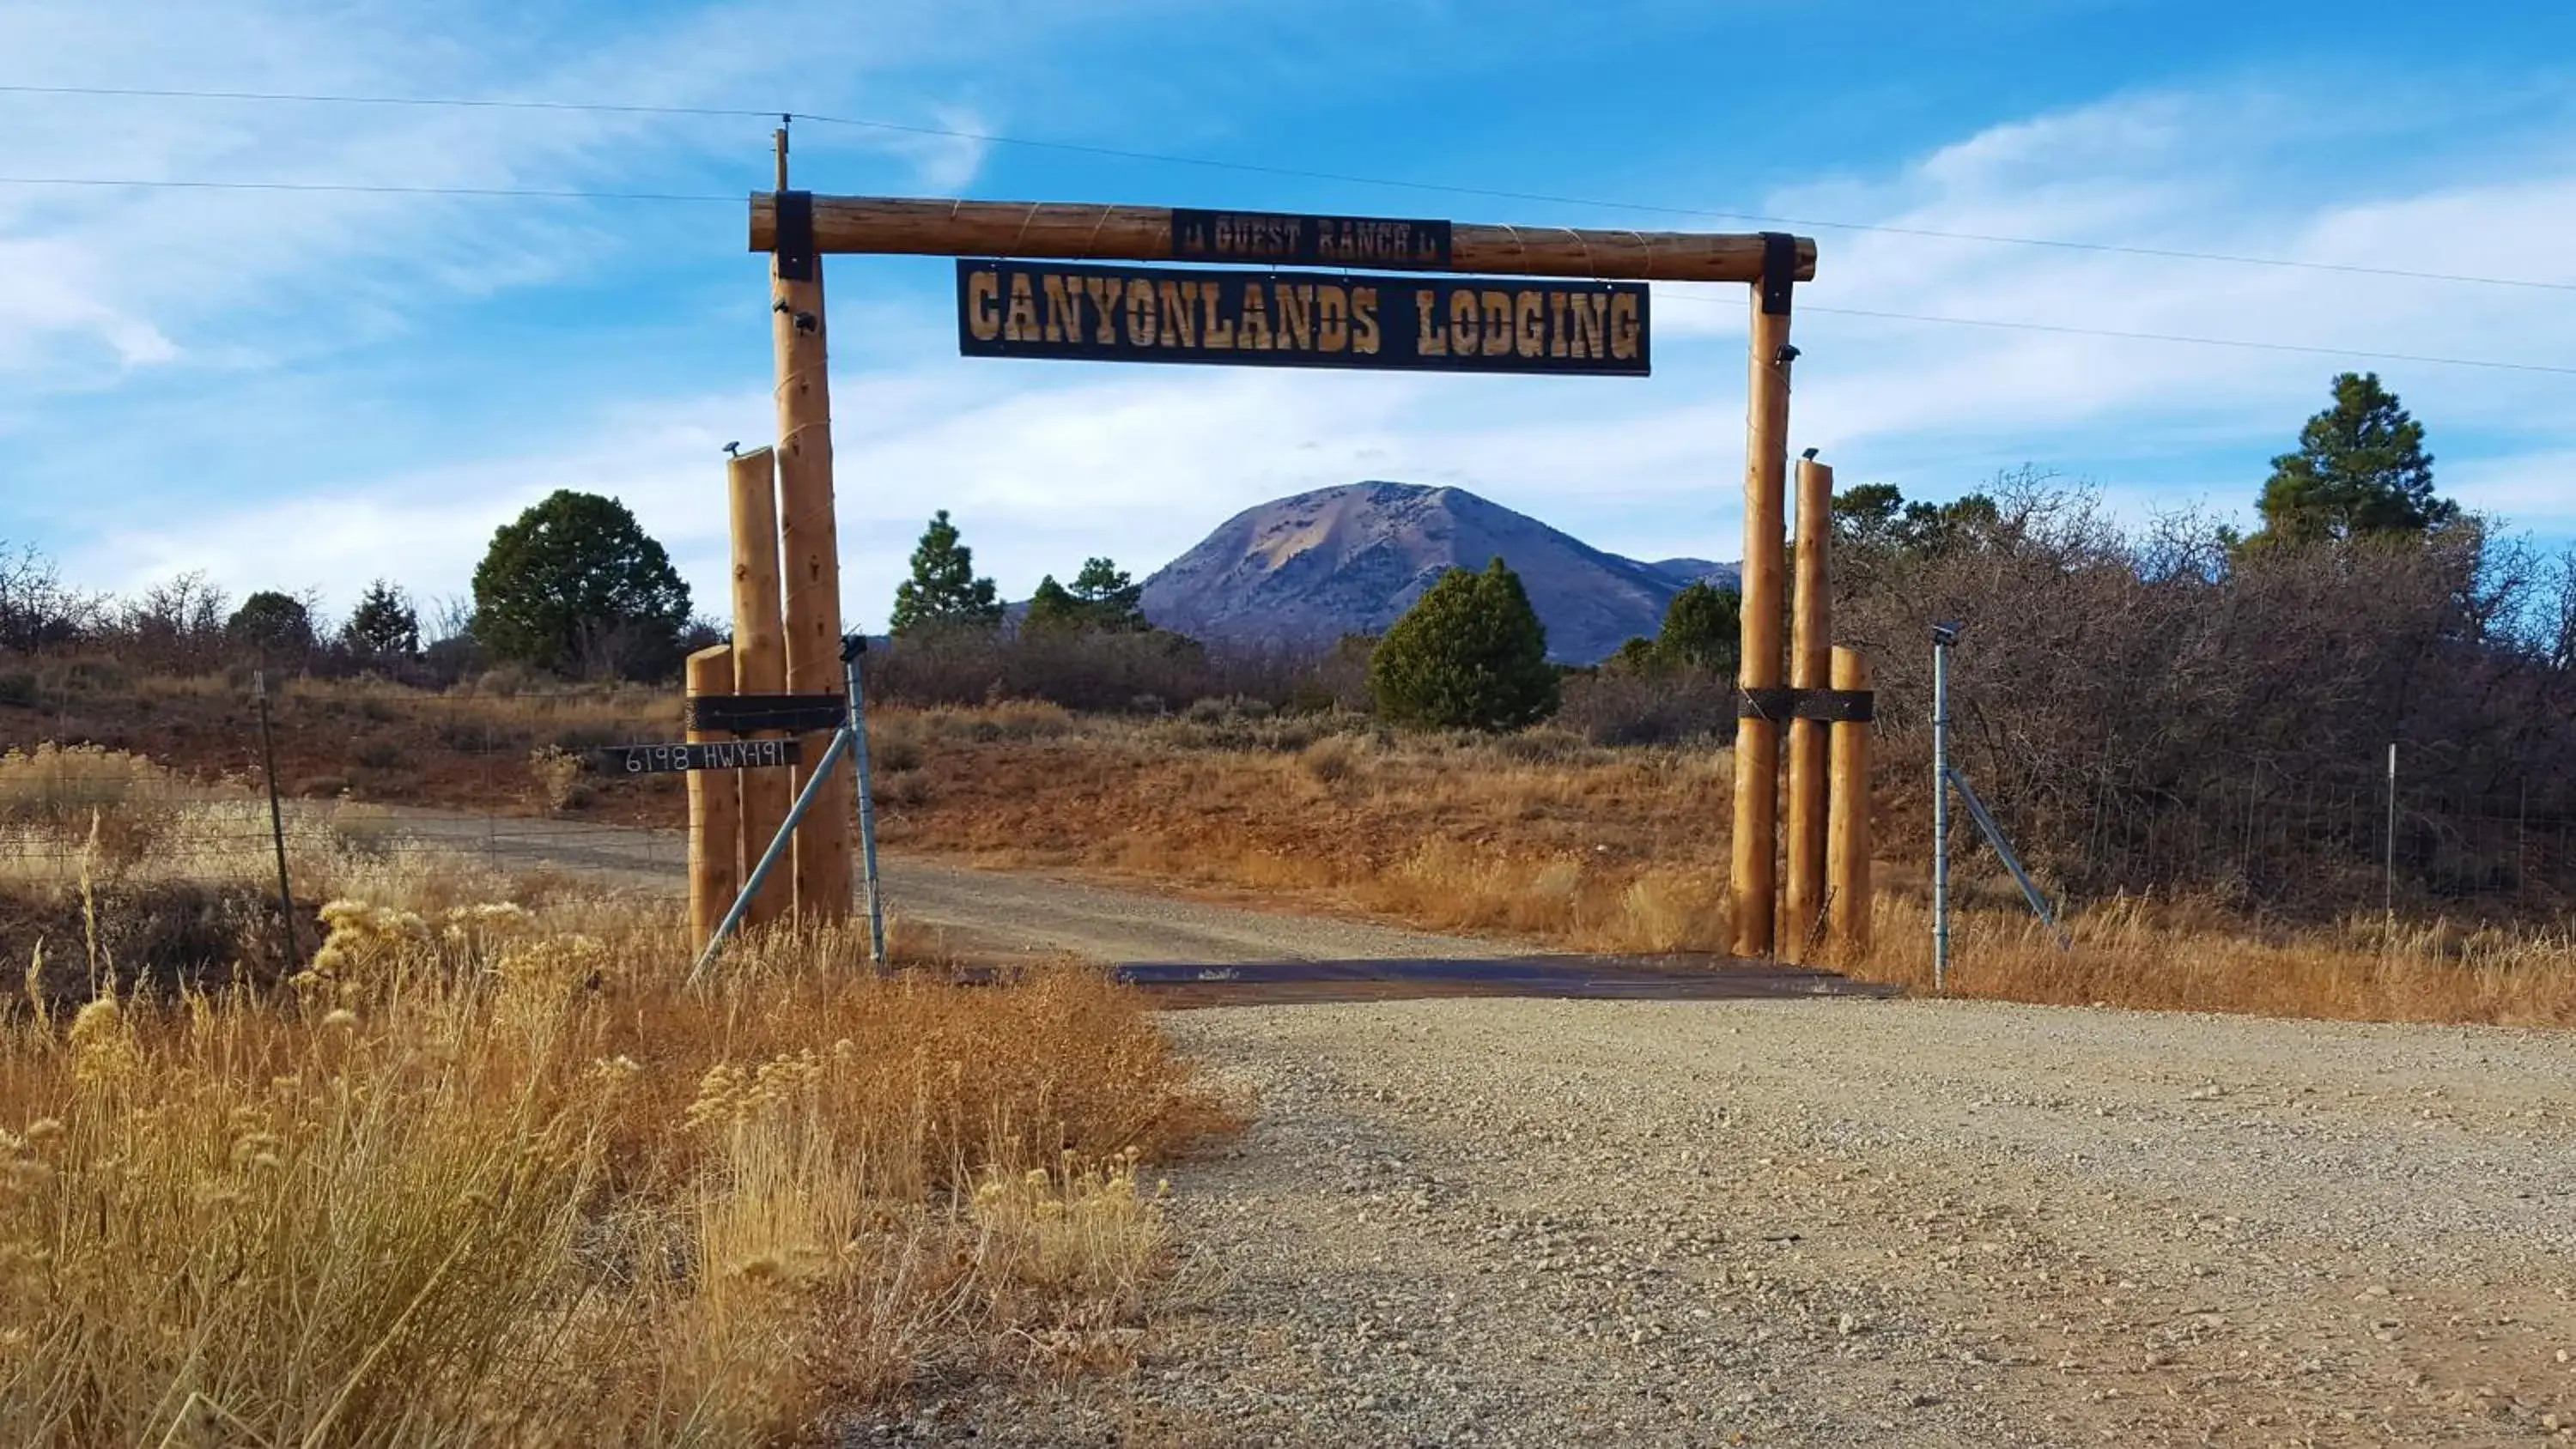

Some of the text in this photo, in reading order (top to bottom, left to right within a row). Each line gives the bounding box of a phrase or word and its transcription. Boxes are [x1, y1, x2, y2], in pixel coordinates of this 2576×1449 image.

[1215, 215, 1412, 258] GUEST RANCH
[969, 270, 1640, 360] CANYONLANDS LODGING
[626, 744, 689, 772] 6198
